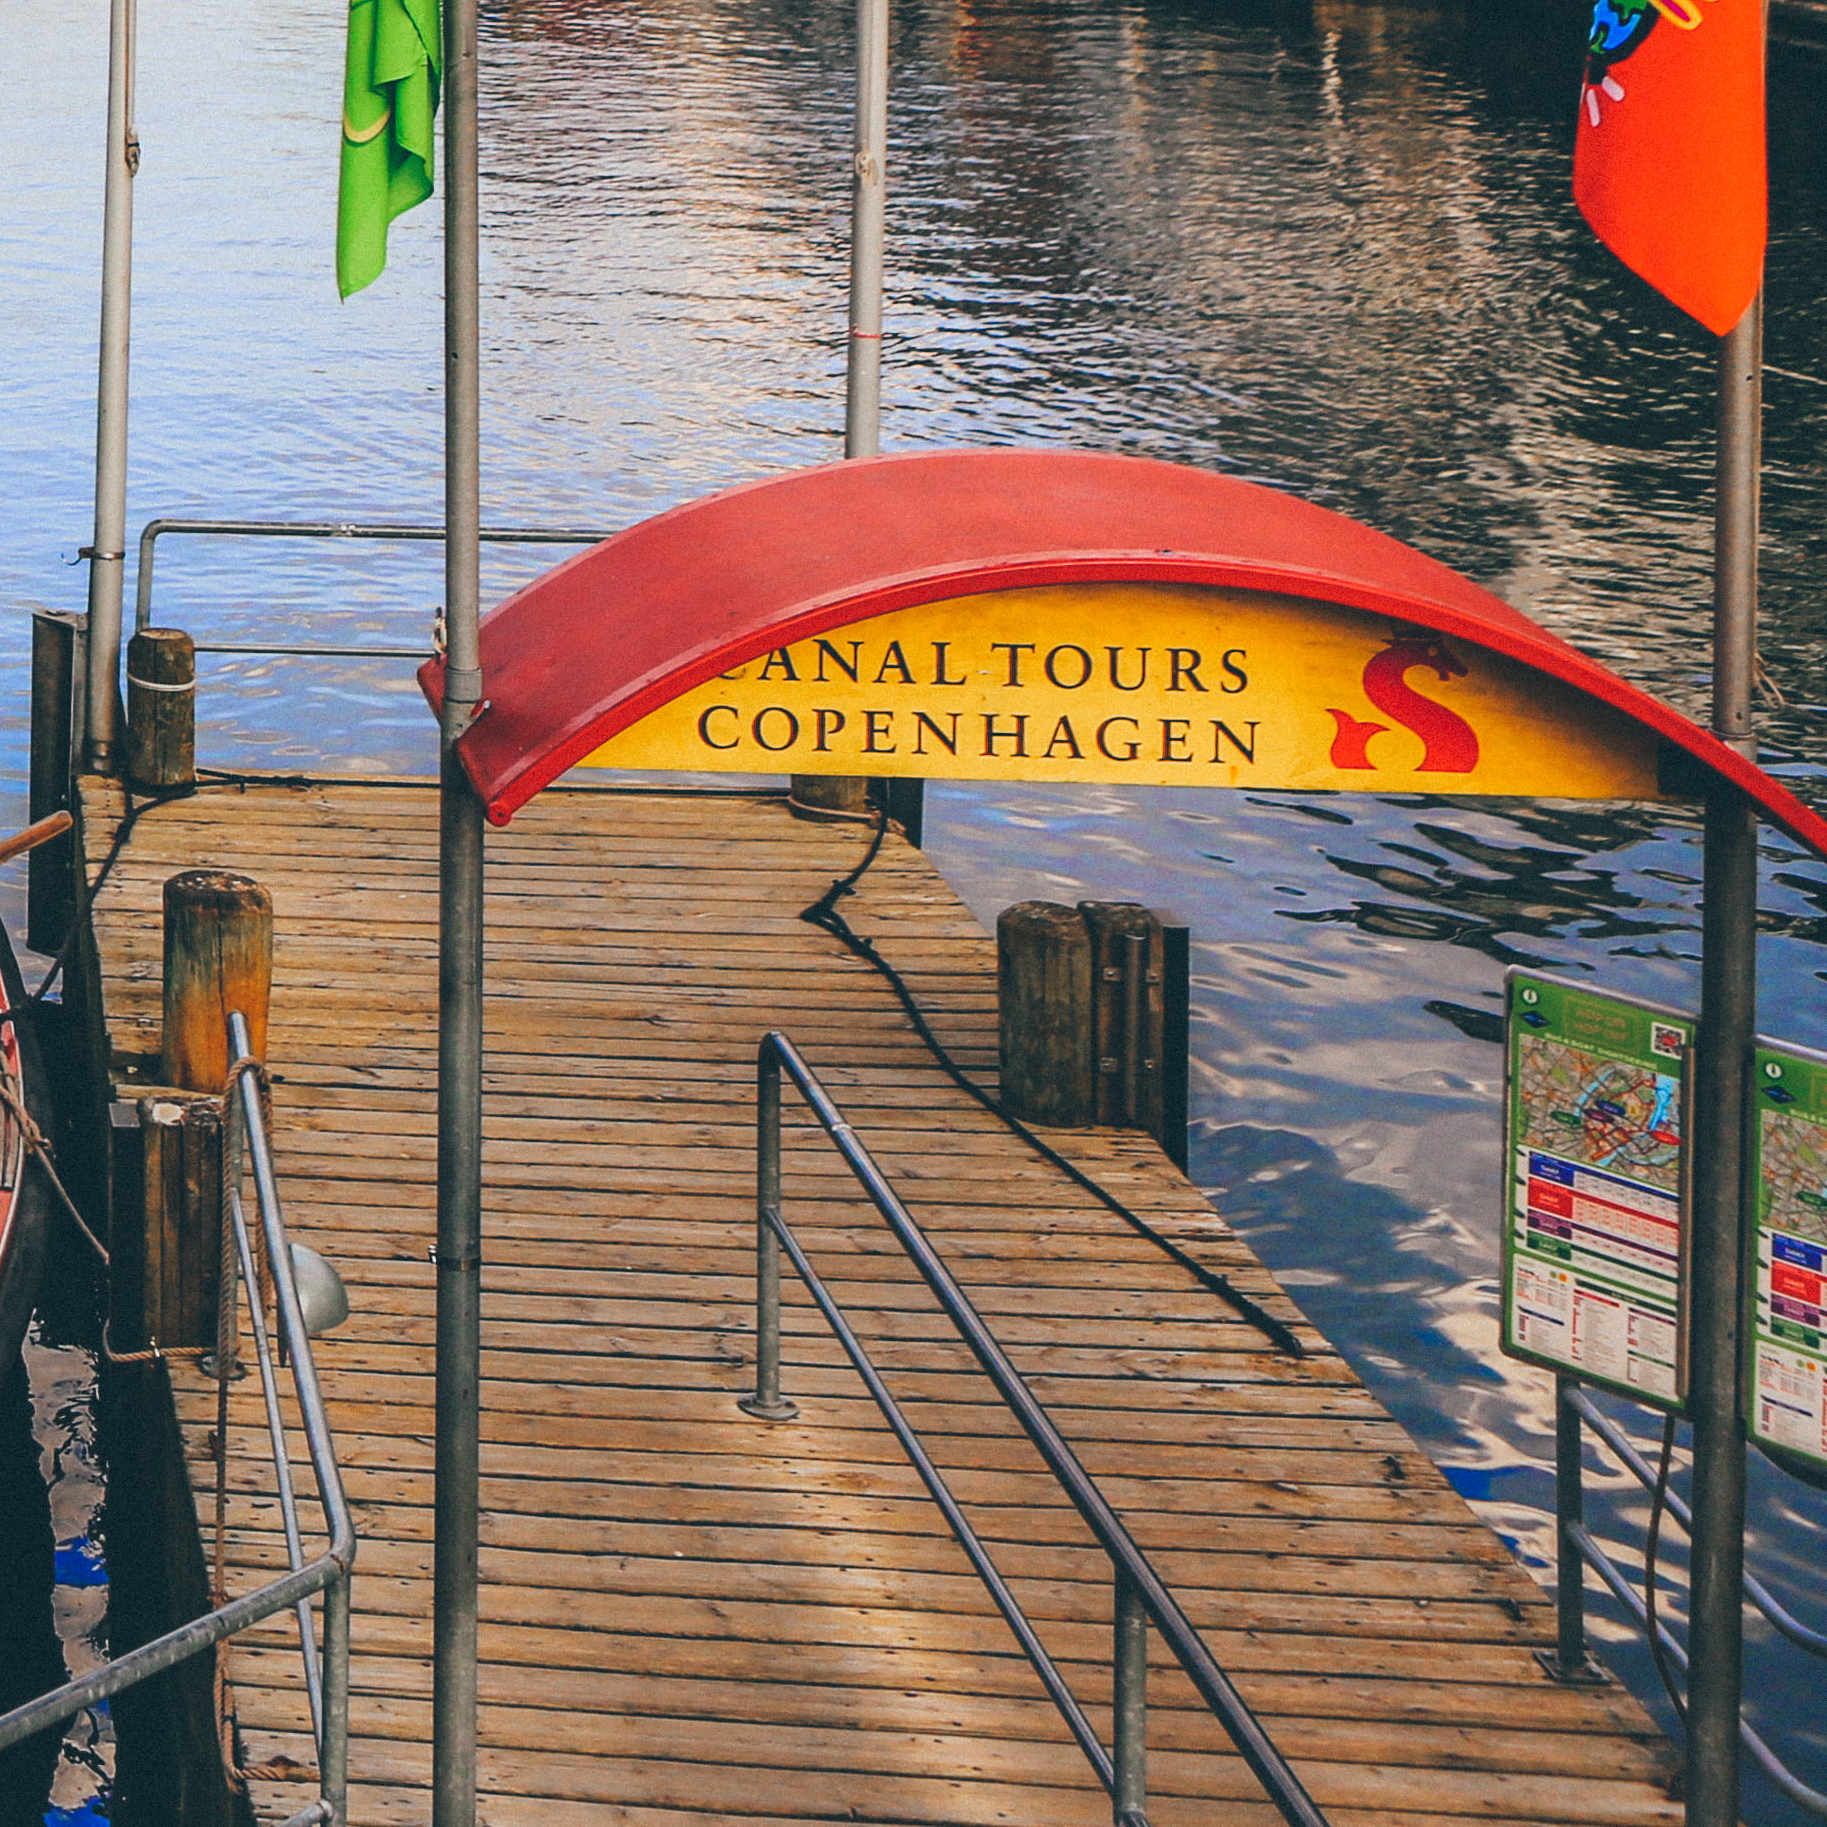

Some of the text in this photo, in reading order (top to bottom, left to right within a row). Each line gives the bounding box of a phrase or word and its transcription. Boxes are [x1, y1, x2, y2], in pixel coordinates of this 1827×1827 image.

[717, 638, 1249, 695] ANAL TOURS
[697, 704, 1263, 765] COPENHAGEN
